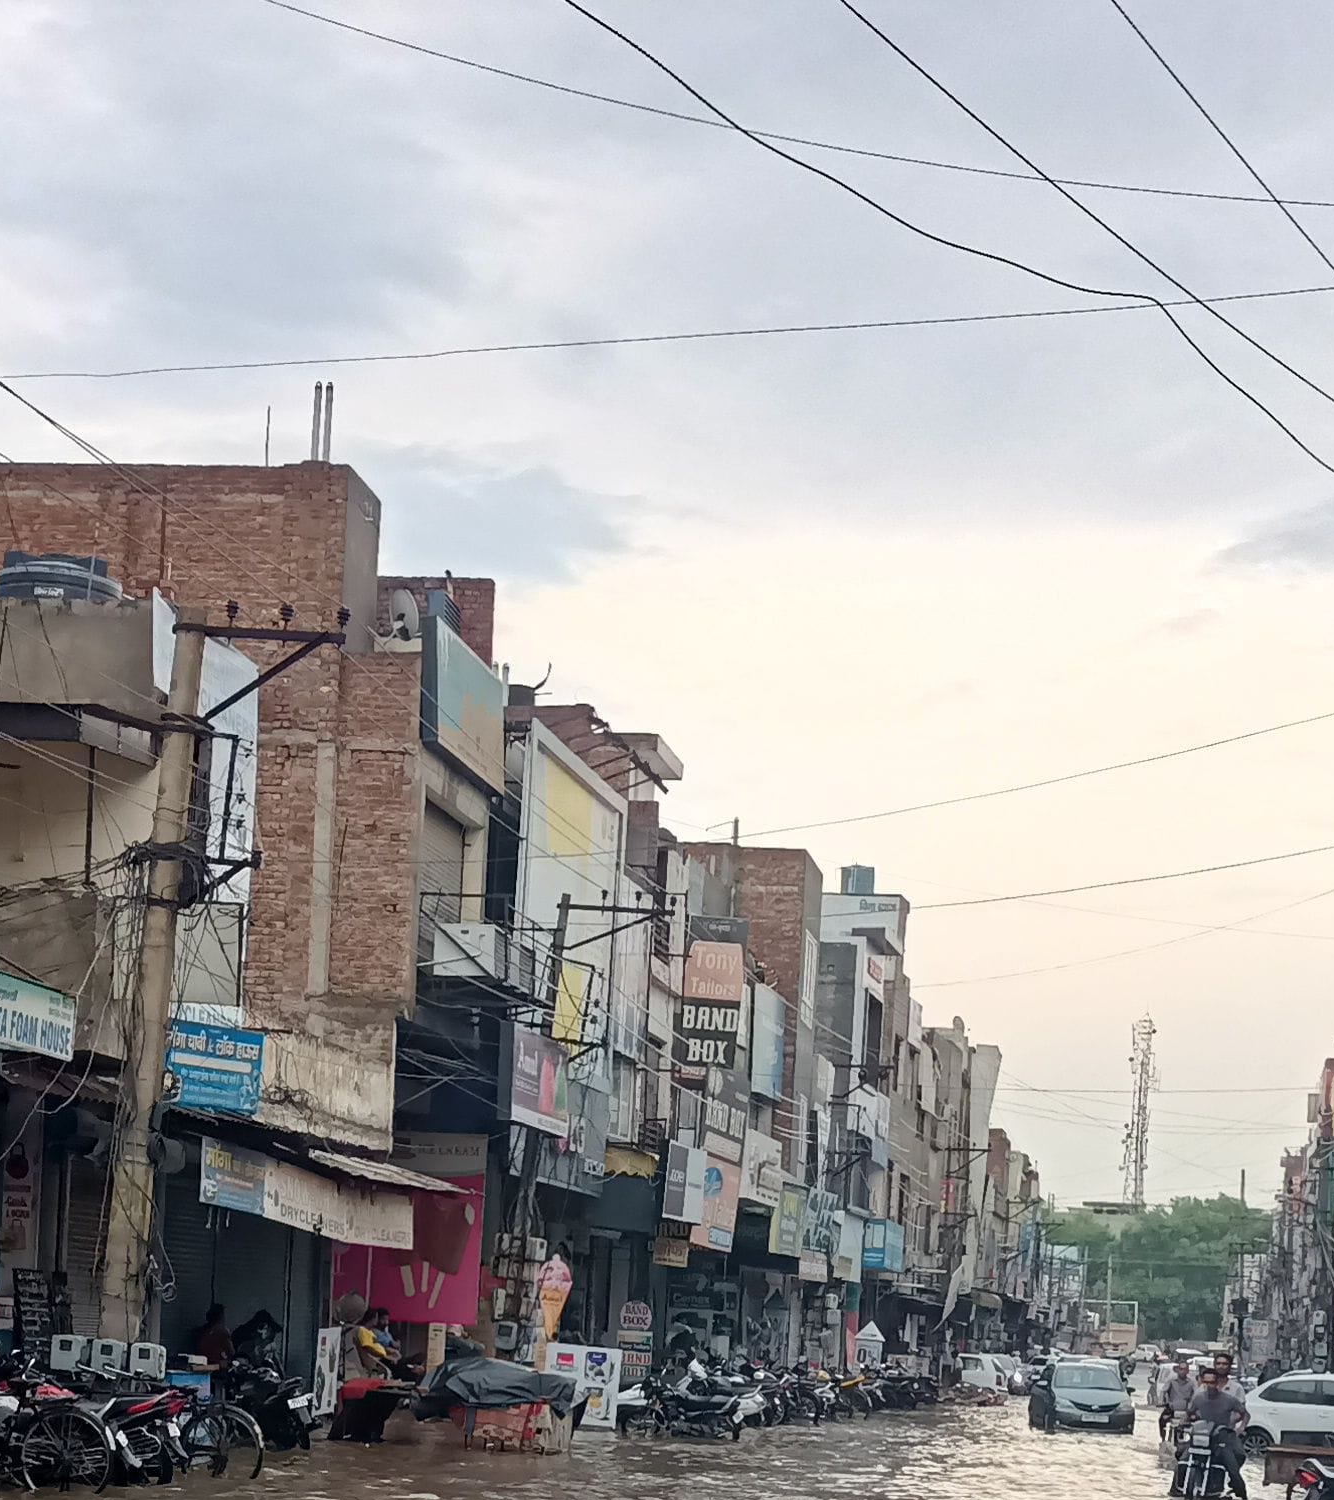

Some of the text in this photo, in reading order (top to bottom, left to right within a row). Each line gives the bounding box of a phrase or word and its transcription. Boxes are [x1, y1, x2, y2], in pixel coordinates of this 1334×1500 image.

[690, 976, 737, 997] Tailors
[682, 1004, 739, 1033] BAND
[10, 1010, 38, 1046] FOAM
[39, 1018, 71, 1056] HOUSE
[687, 1038, 728, 1065] BOX
[623, 1315, 649, 1327] BOX
